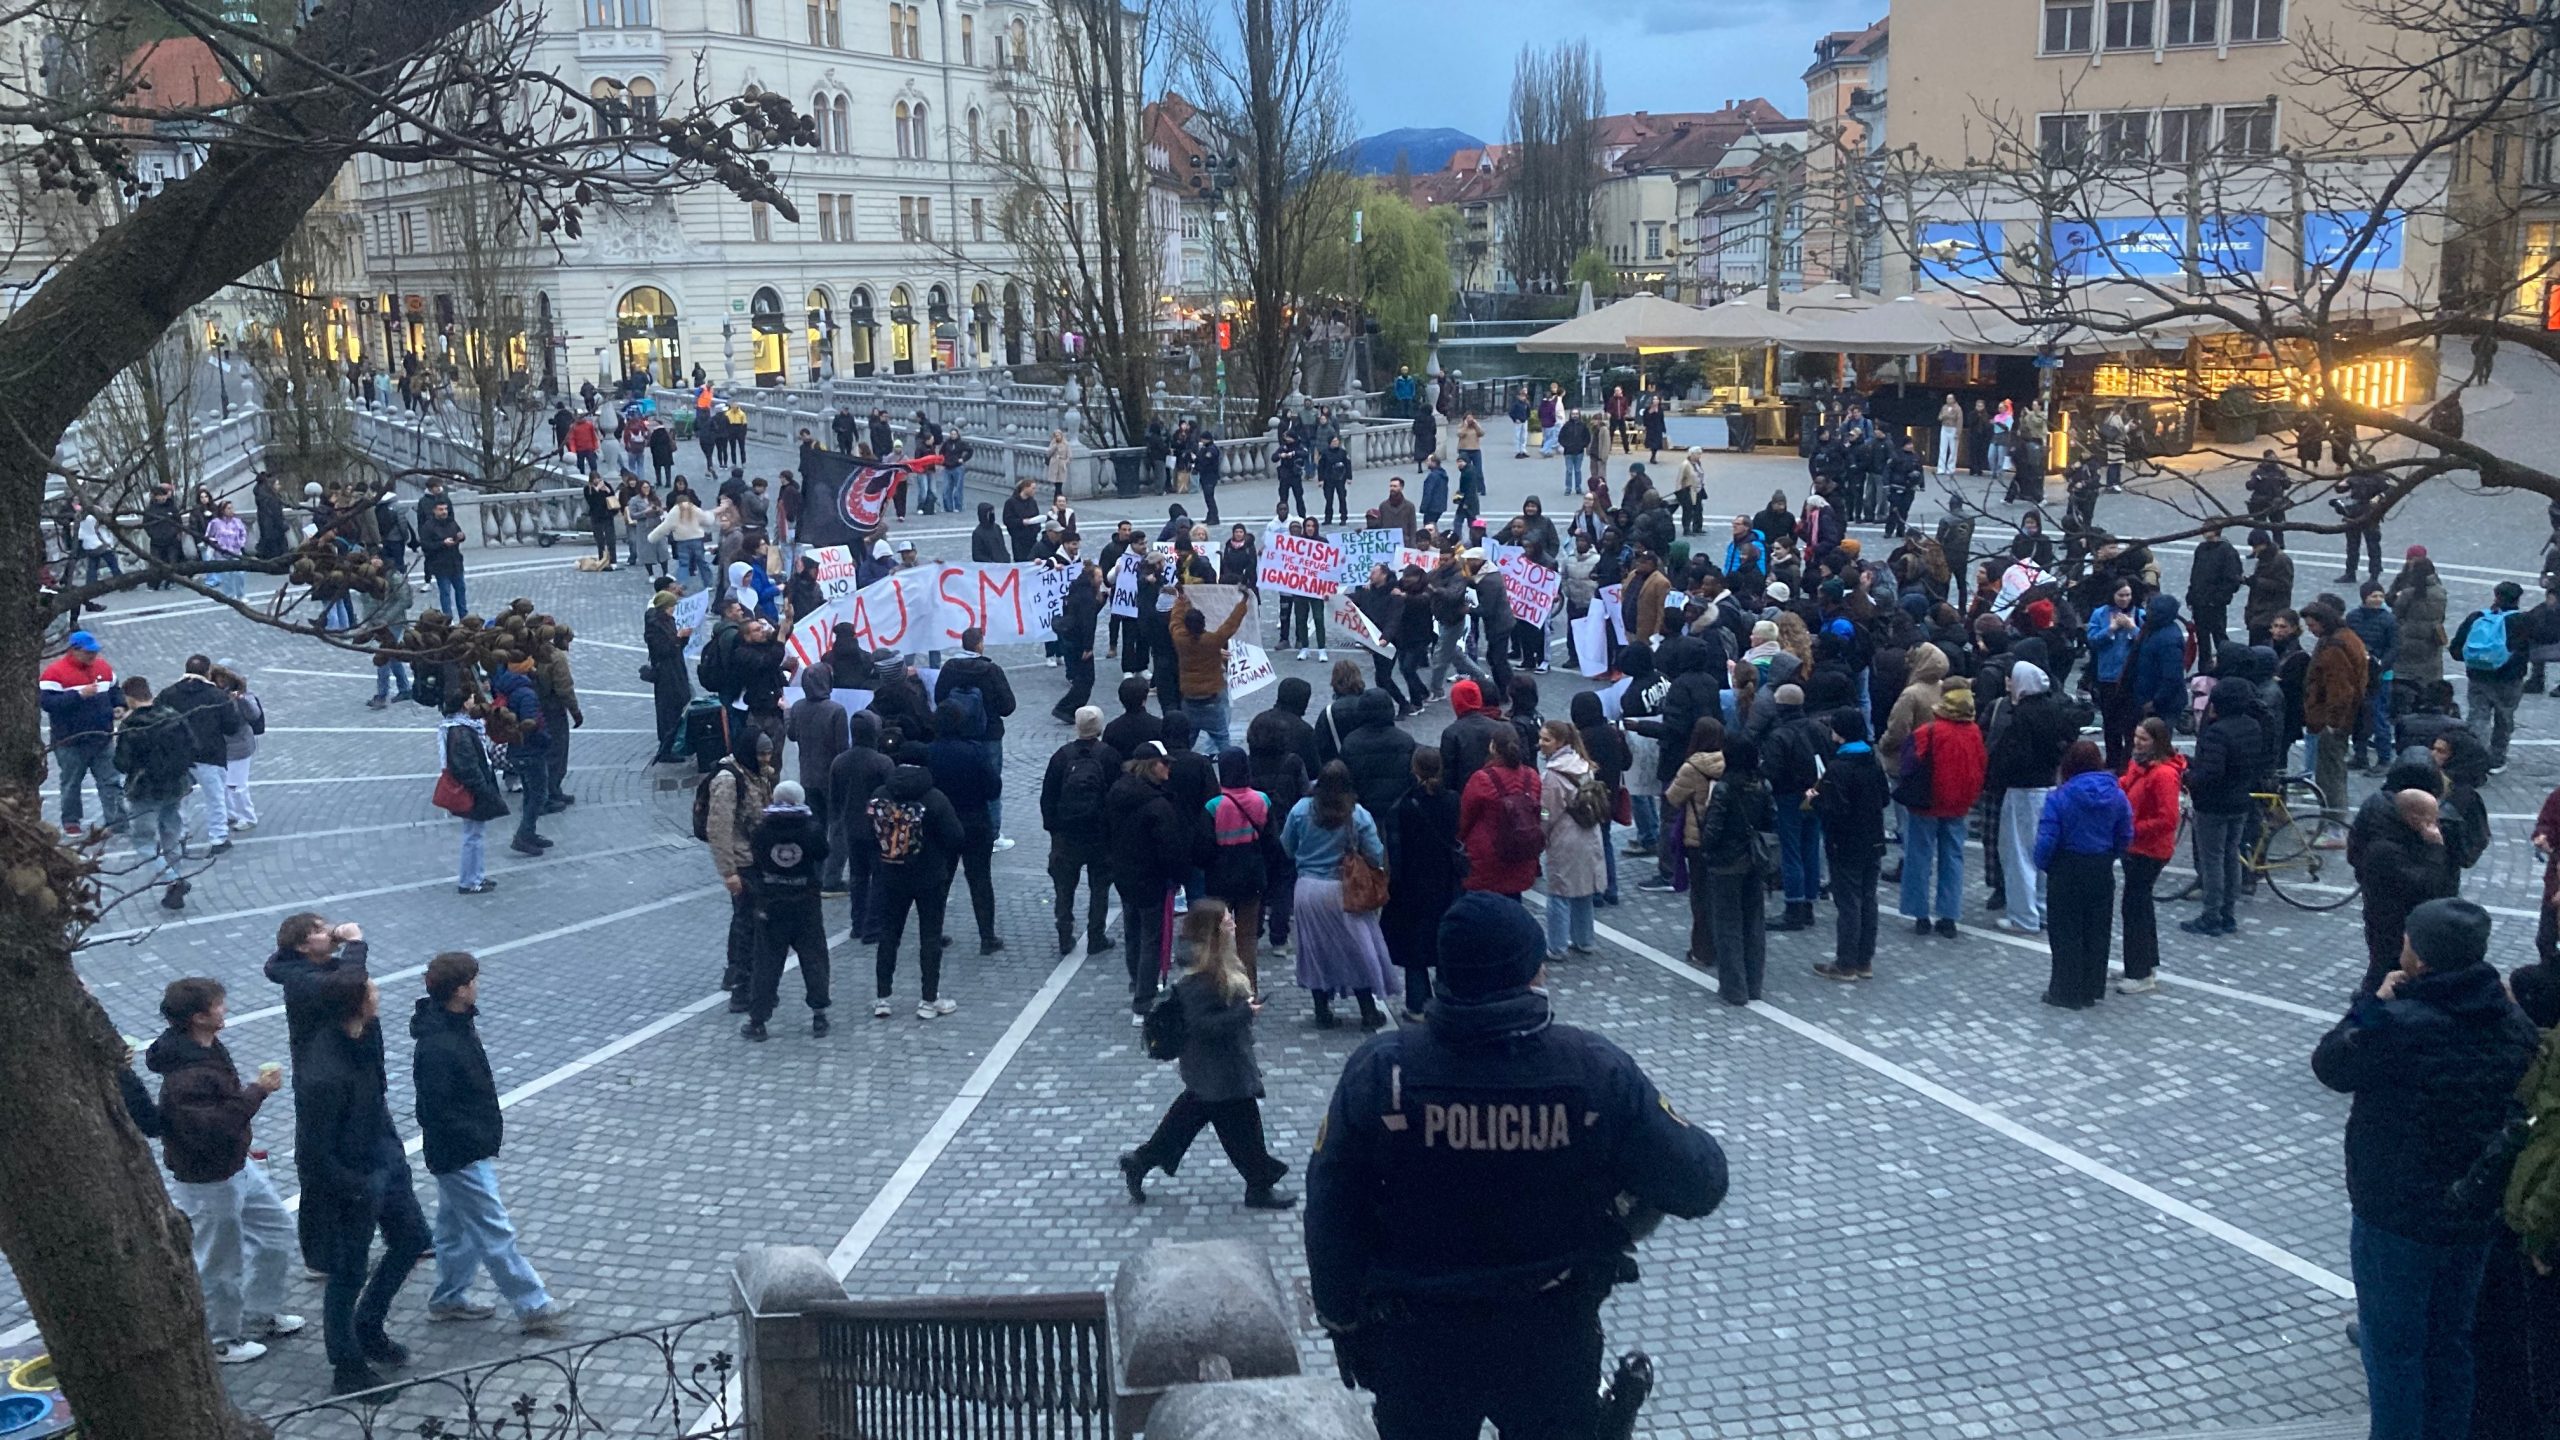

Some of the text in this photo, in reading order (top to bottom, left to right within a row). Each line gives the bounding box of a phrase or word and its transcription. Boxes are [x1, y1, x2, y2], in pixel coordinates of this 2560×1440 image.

[1341, 529, 1391, 543] RESPECT
[821, 548, 840, 565] NO
[1275, 534, 1340, 568] RACISM
[816, 562, 855, 582] JUSTICE
[1266, 551, 1331, 573] IS THE REFUGE
[1512, 553, 1556, 588] STOP
[829, 579, 848, 595] NO
[1047, 589, 1054, 598] A
[1424, 1102, 1572, 1150] POLICIJA
